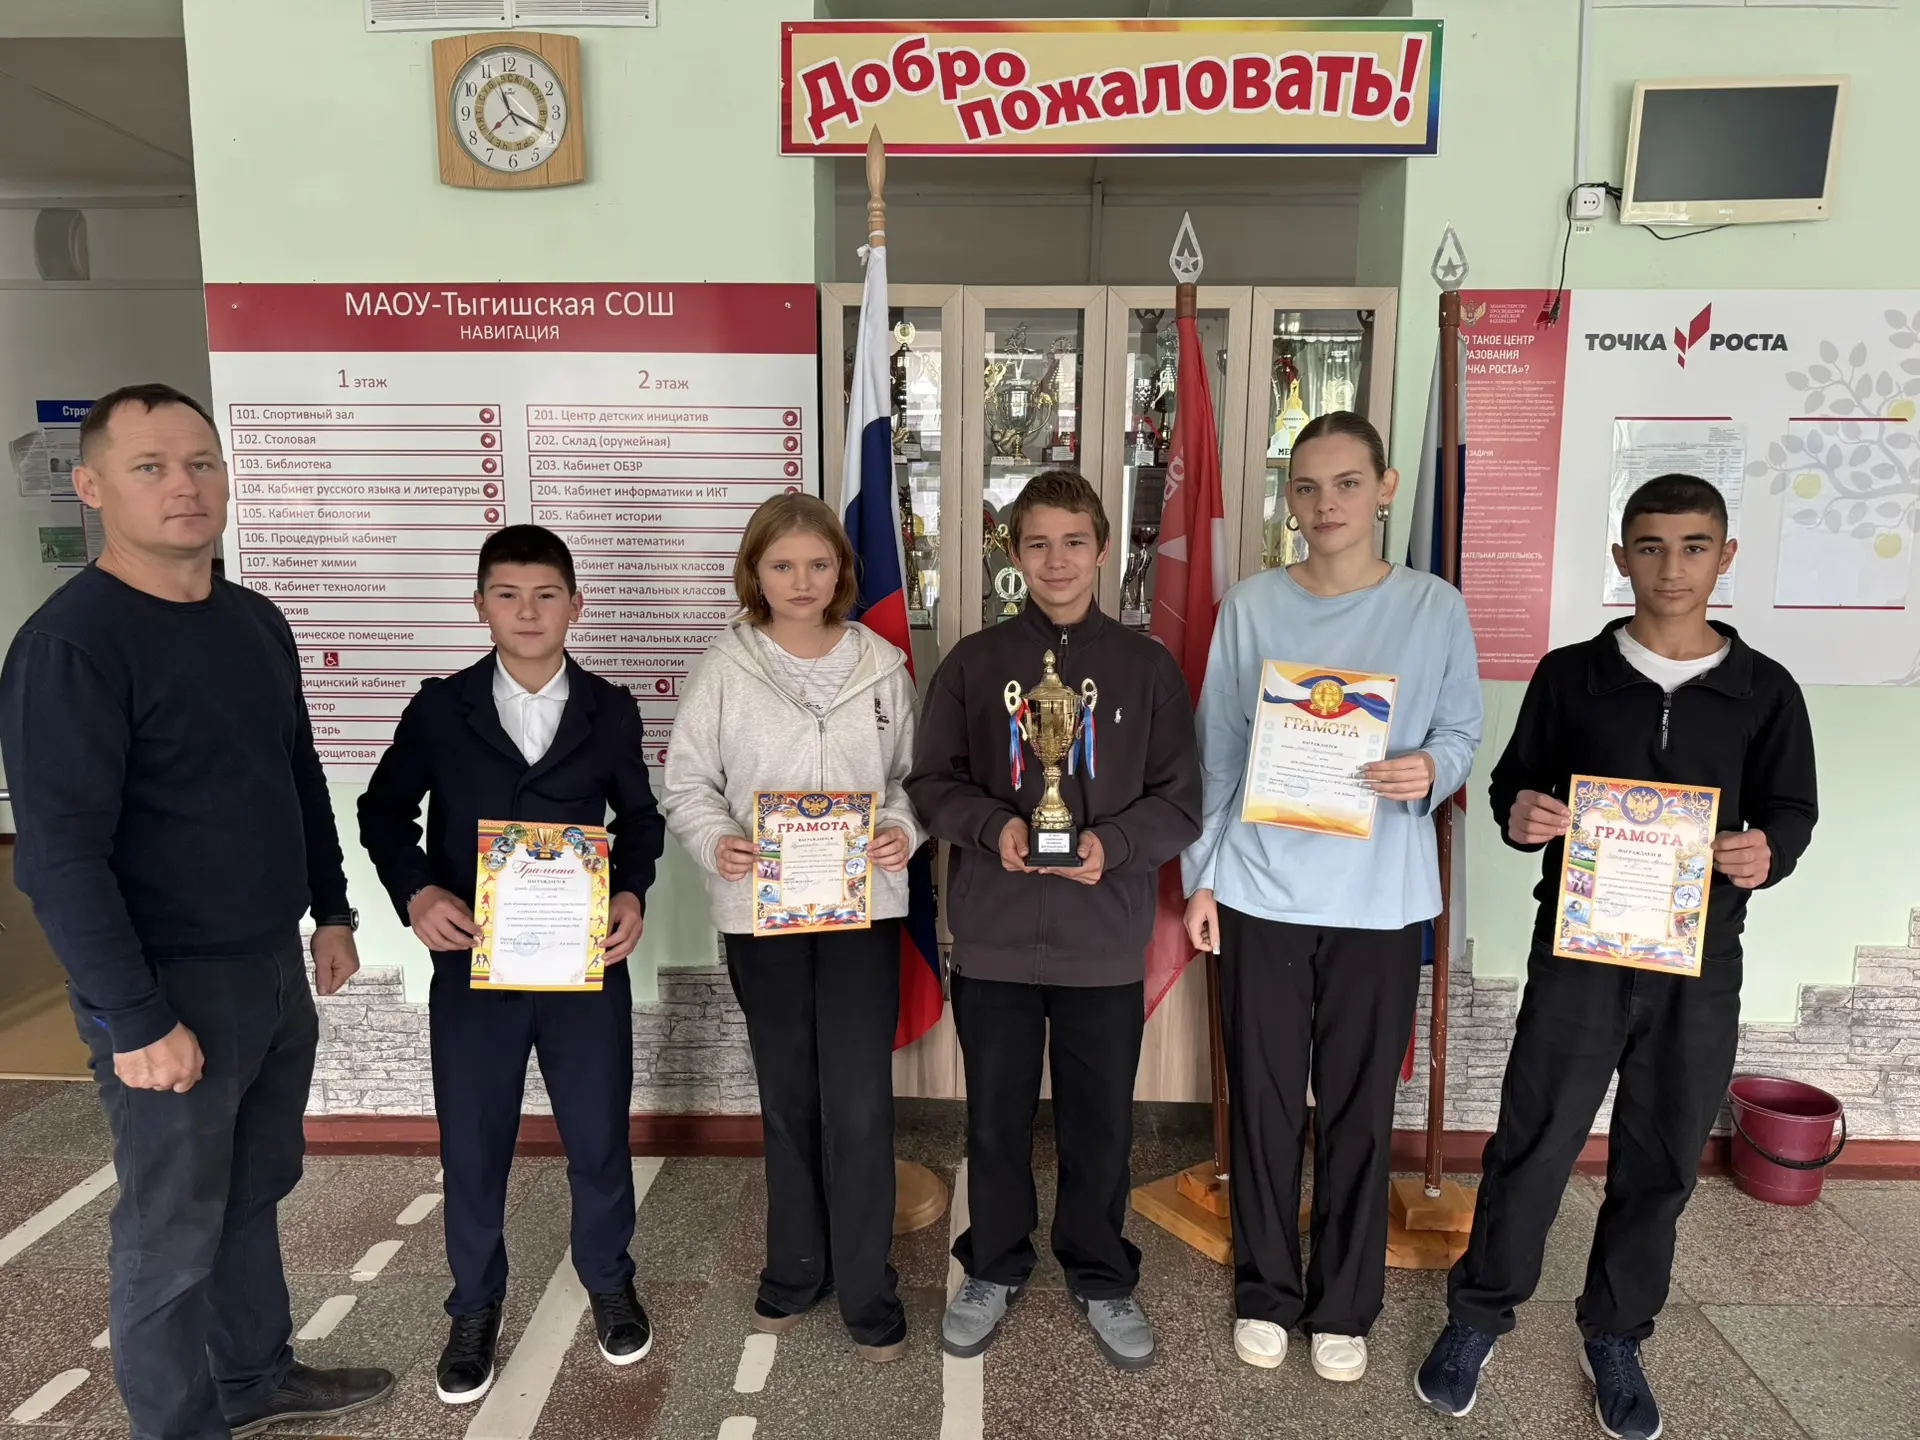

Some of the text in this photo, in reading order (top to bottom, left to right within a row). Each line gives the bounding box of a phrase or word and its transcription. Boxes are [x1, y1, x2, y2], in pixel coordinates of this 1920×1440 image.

[481, 64, 491, 78] 11
[502, 57, 516, 72] 12
[529, 64, 534, 78] 1
[465, 82, 477, 97] 10
[545, 81, 554, 96] 2
[801, 36, 1027, 140] Добро
[955, 36, 1425, 141] пожаловать!
[461, 106, 470, 121] 9
[552, 105, 560, 120] 3
[469, 130, 477, 145] 8
[486, 148, 494, 162] 7
[509, 154, 518, 168] 6
[531, 148, 540, 162] 5
[345, 291, 674, 317] МАОУ-Тыгишская СОШ
[460, 325, 559, 342] НАВИГАЦИЯ
[1472, 335, 1501, 345] ТАКОЕ
[1504, 335, 1535, 347] ЦЕНТР
[1585, 333, 1788, 351] ТОЧКА РОСТА
[1466, 350, 1519, 360] РАЗОВАНИЯ
[1489, 364, 1530, 375] РОСТА»?
[337, 369, 388, 388] 1 этаж
[638, 370, 689, 390] 2 этаж
[236, 409, 354, 423] 101. Спортивный зал
[534, 410, 709, 424] 201. Центр детских инициатив
[238, 434, 316, 445] 102. Столовая
[535, 435, 671, 449] 202. Склад (оружейная)
[1278, 448, 1291, 456] МЕ
[239, 459, 332, 469] 103. Библиотека
[536, 460, 643, 471] 203. Кабинет ОБЗР
[241, 484, 481, 498] 104. Кабинет русского языка и литературы
[537, 485, 729, 499] 204. Кабинет информатики и ИКТ
[242, 508, 371, 519] 105. Кабинет биологии
[538, 510, 662, 523] 205. Кабинет истории
[244, 532, 397, 546] 106. Процедурный кабинет
[566, 535, 685, 547] Кабинет математики
[247, 557, 357, 567] 107. Кабинет химии
[1496, 552, 1542, 560] ДЕЯТЕЛЬНОСТЬ
[574, 560, 725, 571] абинет начальных классов
[274, 581, 319, 592] Кабинет
[323, 584, 386, 592] технологии
[576, 585, 726, 596] абинет начальных классов
[579, 609, 726, 620] абинет начальных классов
[294, 631, 414, 642] ническое помещение
[571, 632, 718, 643] Кабинет начальных класс
[573, 656, 685, 668] Кабинет технологии
[300, 677, 407, 689] дицинский кабинет
[306, 702, 336, 714] ектор
[311, 725, 341, 737] етарь
[1284, 716, 1360, 738] ГРАМОТА
[318, 749, 376, 760] рощитовая
[777, 821, 850, 833] ГРАМОТА
[1595, 825, 1683, 847] ГРАМОТА
[512, 860, 577, 879] Грамота
